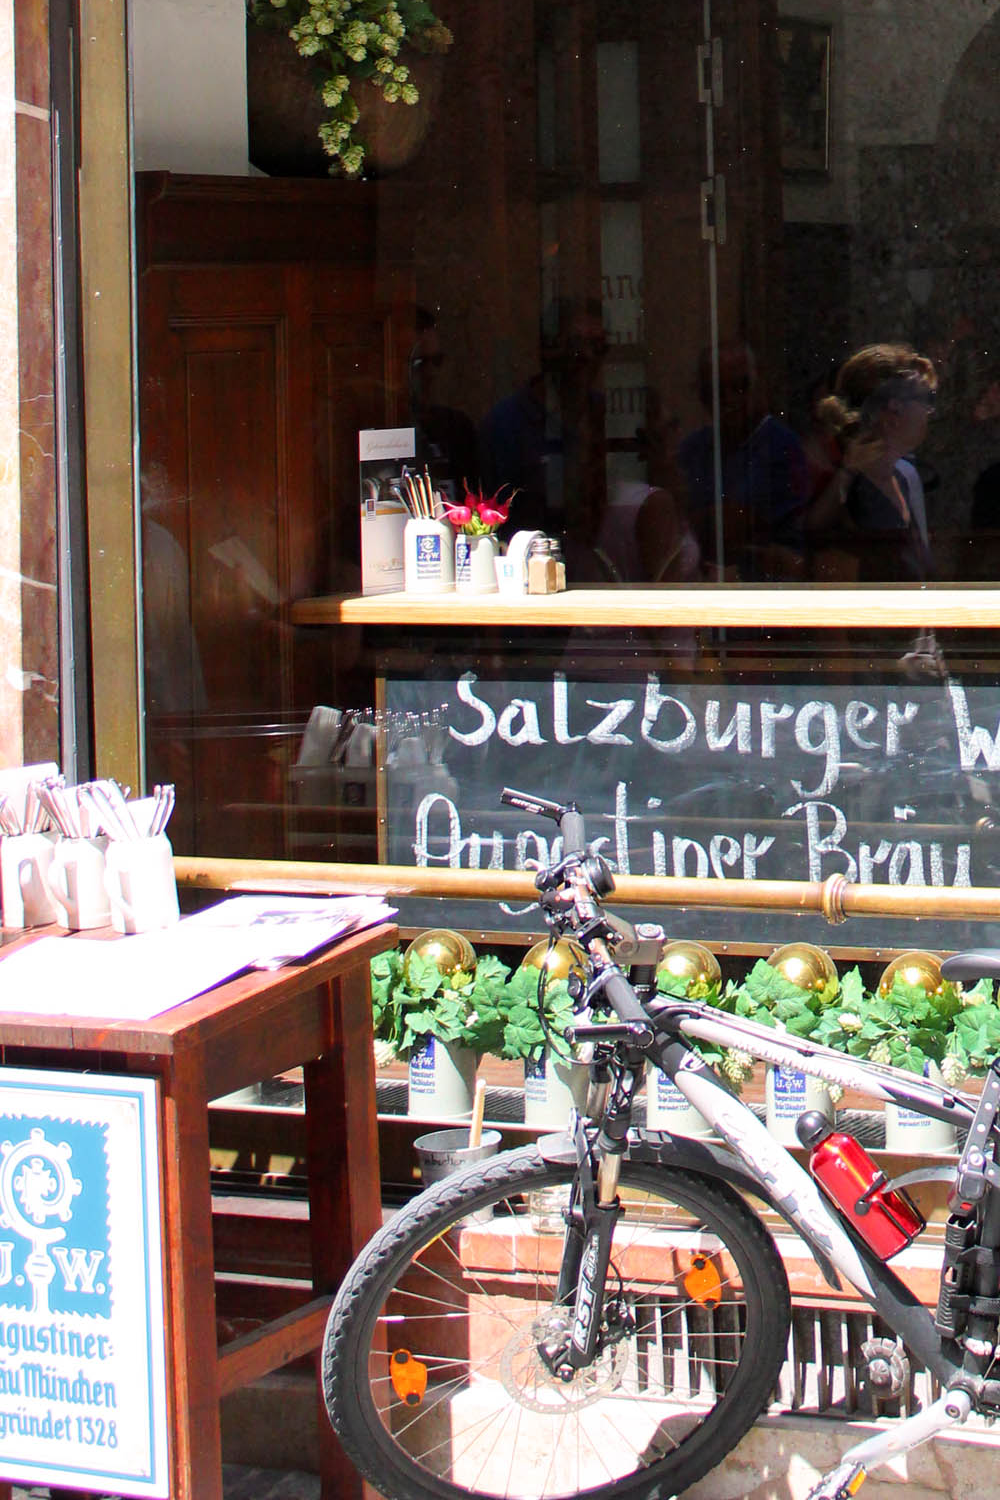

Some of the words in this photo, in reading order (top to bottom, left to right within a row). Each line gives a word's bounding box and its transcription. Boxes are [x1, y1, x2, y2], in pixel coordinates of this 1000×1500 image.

[447, 669, 920, 799] Salzburger
[781, 801, 972, 887] Bräu
[573, 1278, 594, 1350] RST
[75, 1415, 118, 1449] 1328
